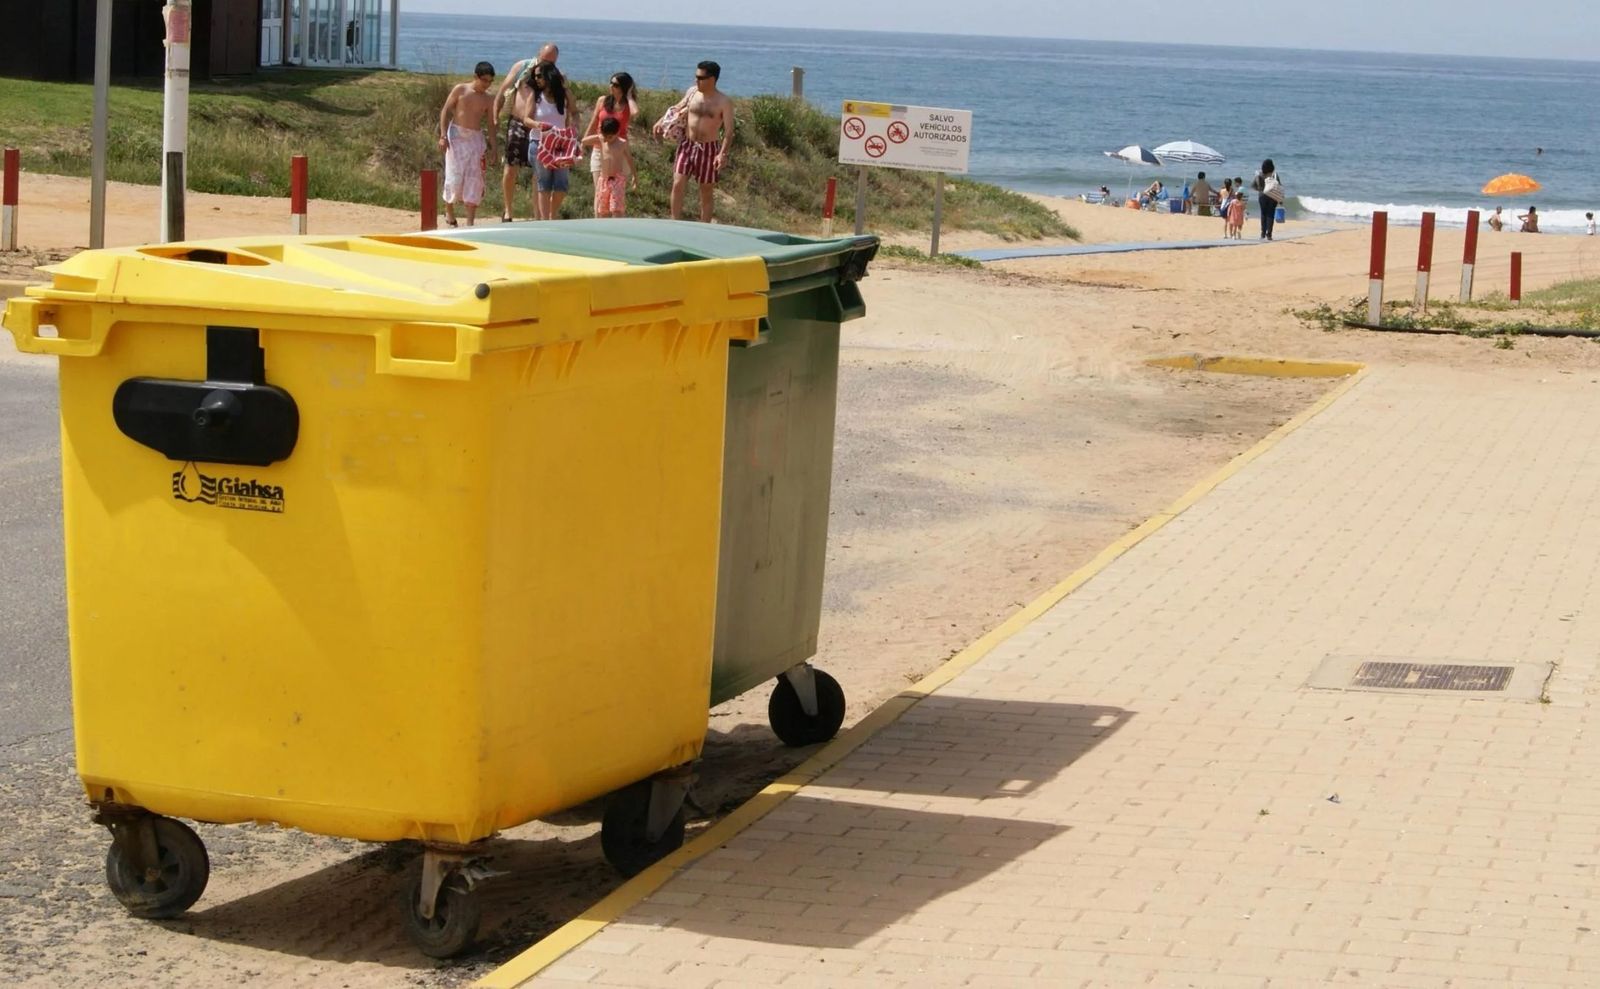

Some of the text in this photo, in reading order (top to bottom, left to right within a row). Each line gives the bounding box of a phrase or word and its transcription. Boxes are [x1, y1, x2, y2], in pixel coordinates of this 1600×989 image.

[929, 114, 954, 122] SALVO
[913, 131, 967, 142] AUTORIZADOS
[218, 477, 284, 500] Giahsa
